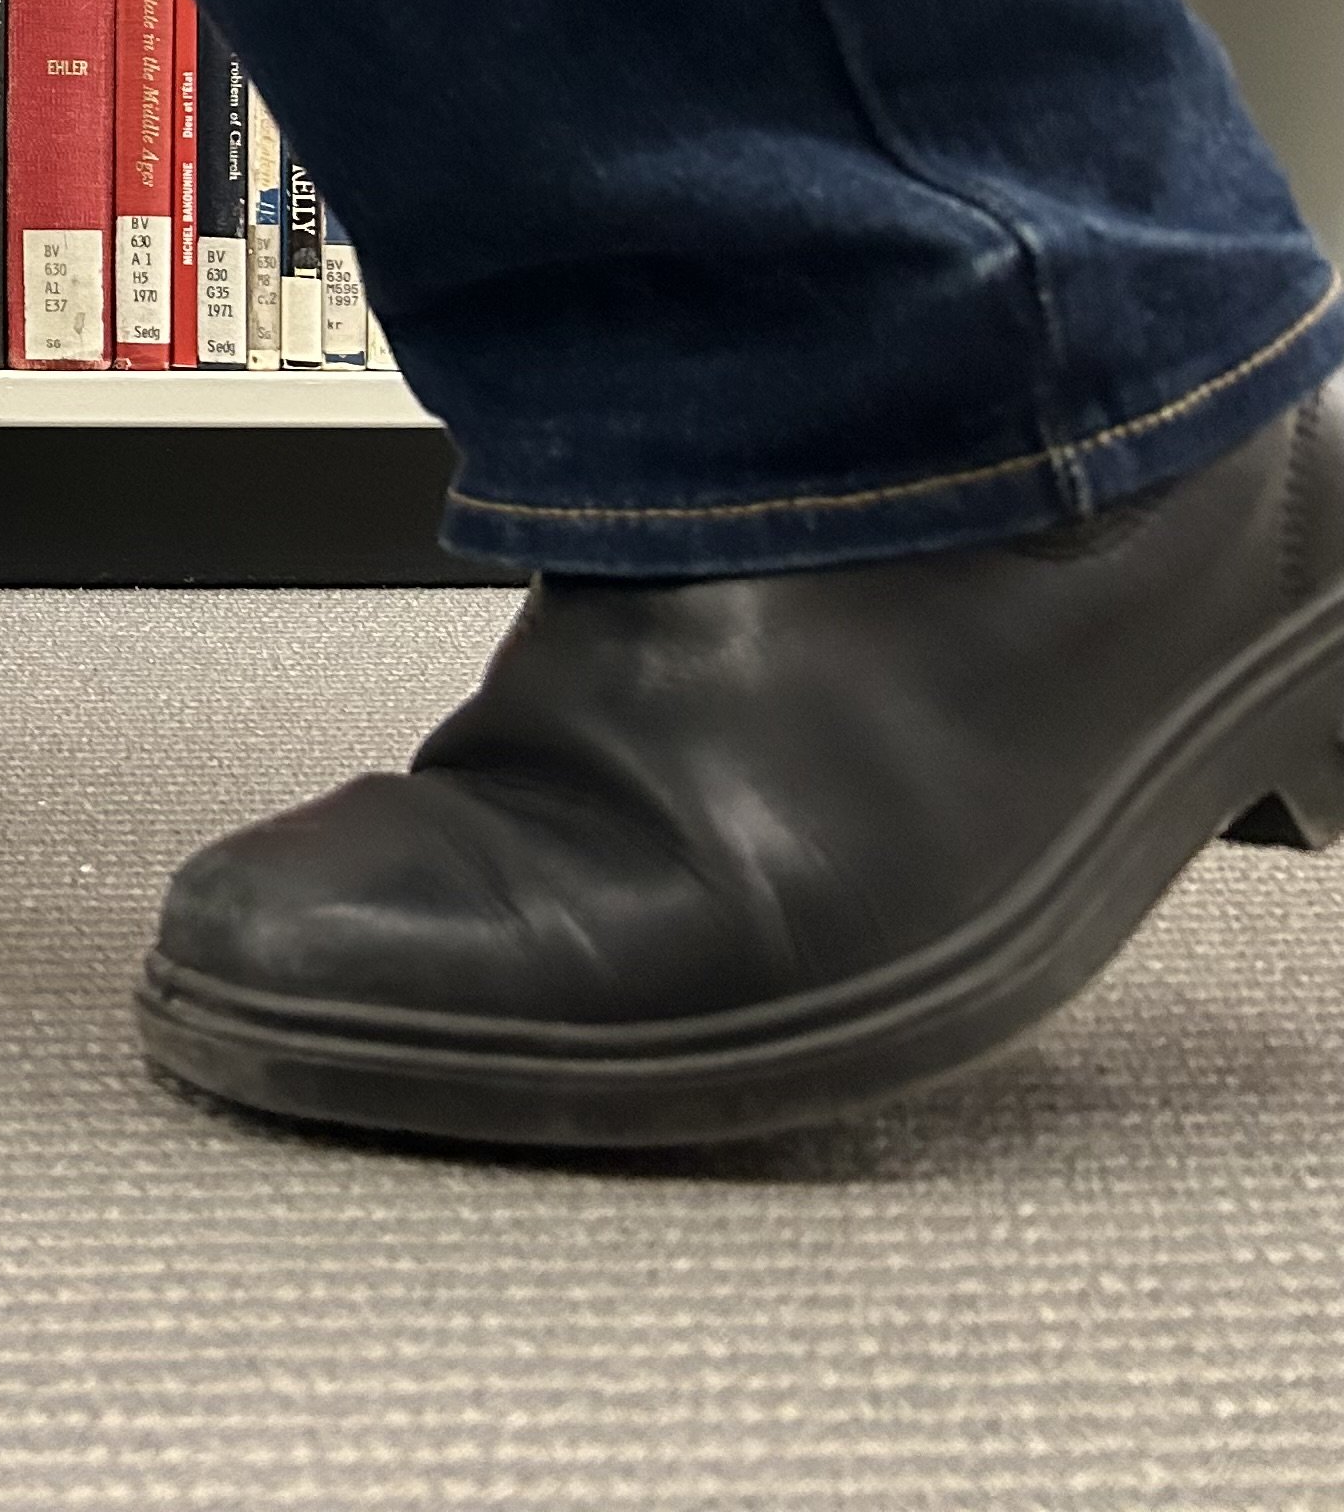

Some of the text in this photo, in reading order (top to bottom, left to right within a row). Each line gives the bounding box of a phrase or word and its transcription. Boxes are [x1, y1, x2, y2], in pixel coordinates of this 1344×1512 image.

[143, 30, 160, 46] in
[47, 60, 88, 75] EHLER
[143, 55, 160, 80] the
[142, 85, 159, 143] Middle
[137, 148, 159, 187] Ages
[182, 163, 193, 265] MICHEL BAKOUNINE
[208, 250, 225, 263] BV
[207, 268, 227, 281] 630
[207, 286, 229, 299] G35
[208, 304, 233, 317] 1971
[208, 340, 235, 356] Sedg
